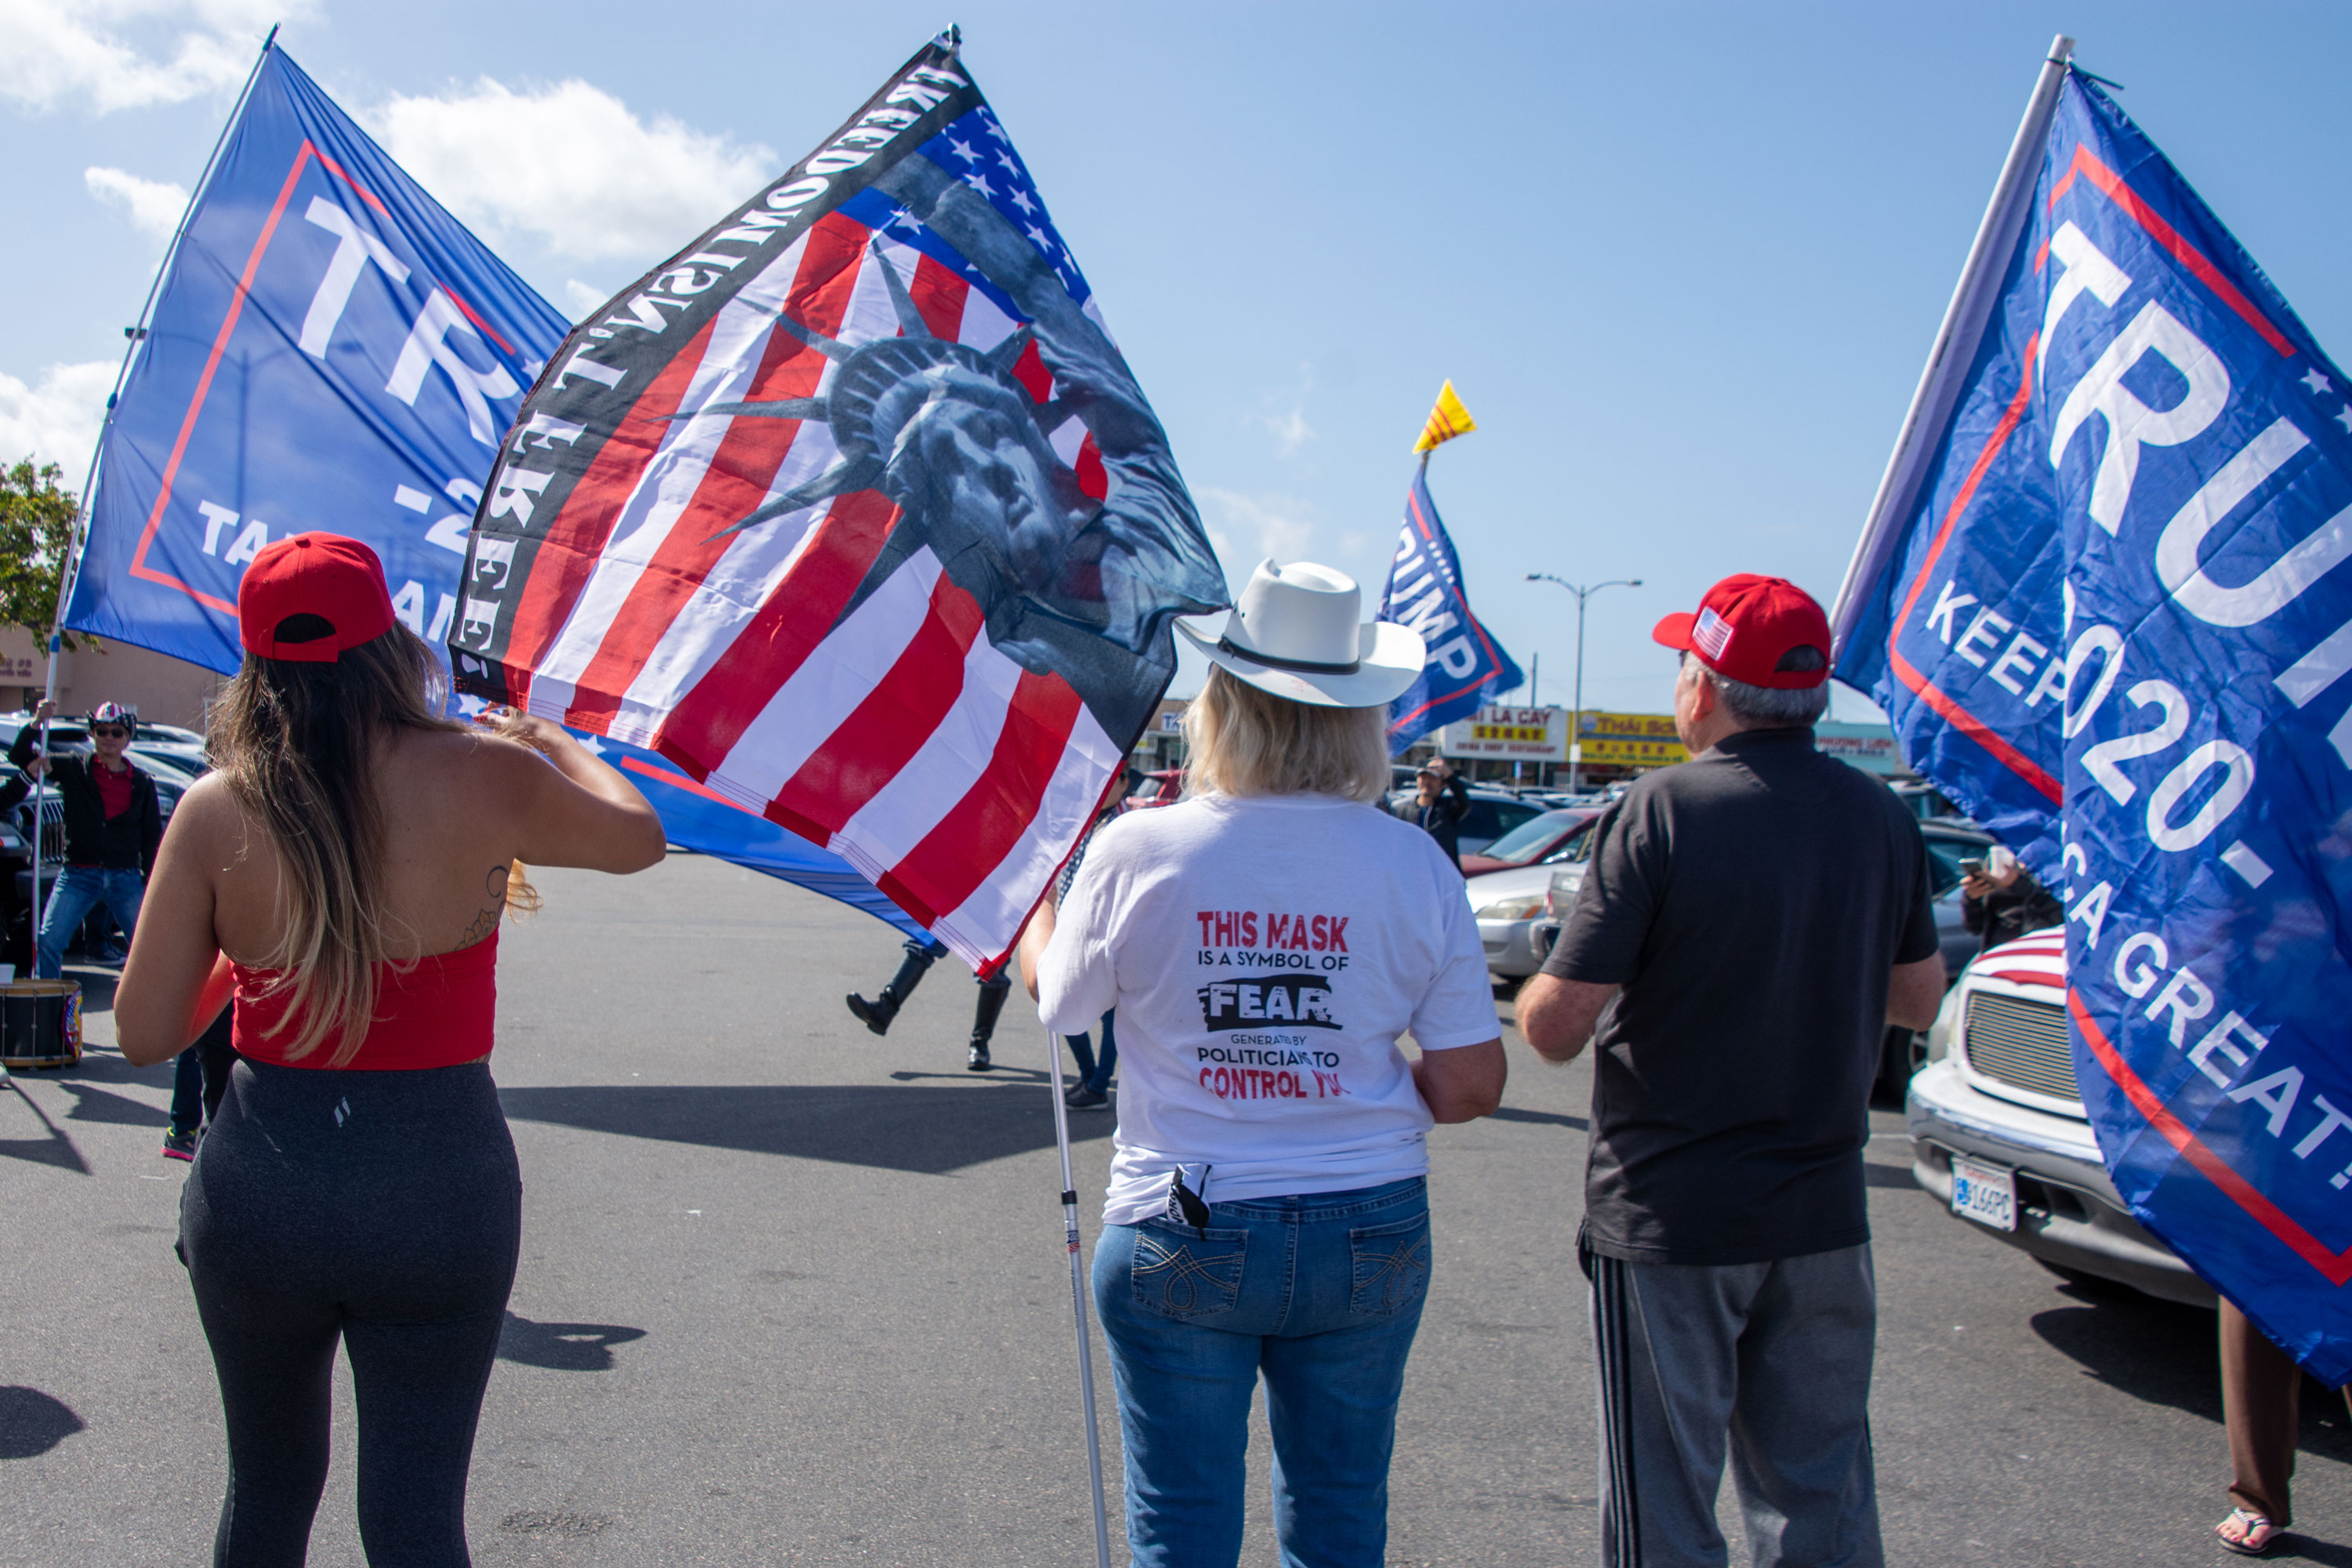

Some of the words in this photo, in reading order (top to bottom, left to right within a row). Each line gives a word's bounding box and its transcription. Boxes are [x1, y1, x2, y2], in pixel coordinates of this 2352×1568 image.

[2040, 219, 2352, 771] TRU
[1197, 911, 1258, 948] THIS
[1266, 913, 1349, 953] MASK
[1198, 950, 1214, 965] IS
[1218, 952, 1232, 965] A
[1237, 951, 1315, 970] SYMBOL
[1321, 956, 1349, 971] OF
[1210, 983, 1332, 1022] FEAR
[1293, 1035, 1307, 1046] BY
[1313, 1051, 1340, 1068] TO
[1200, 1067, 1308, 1099] CONTROL
